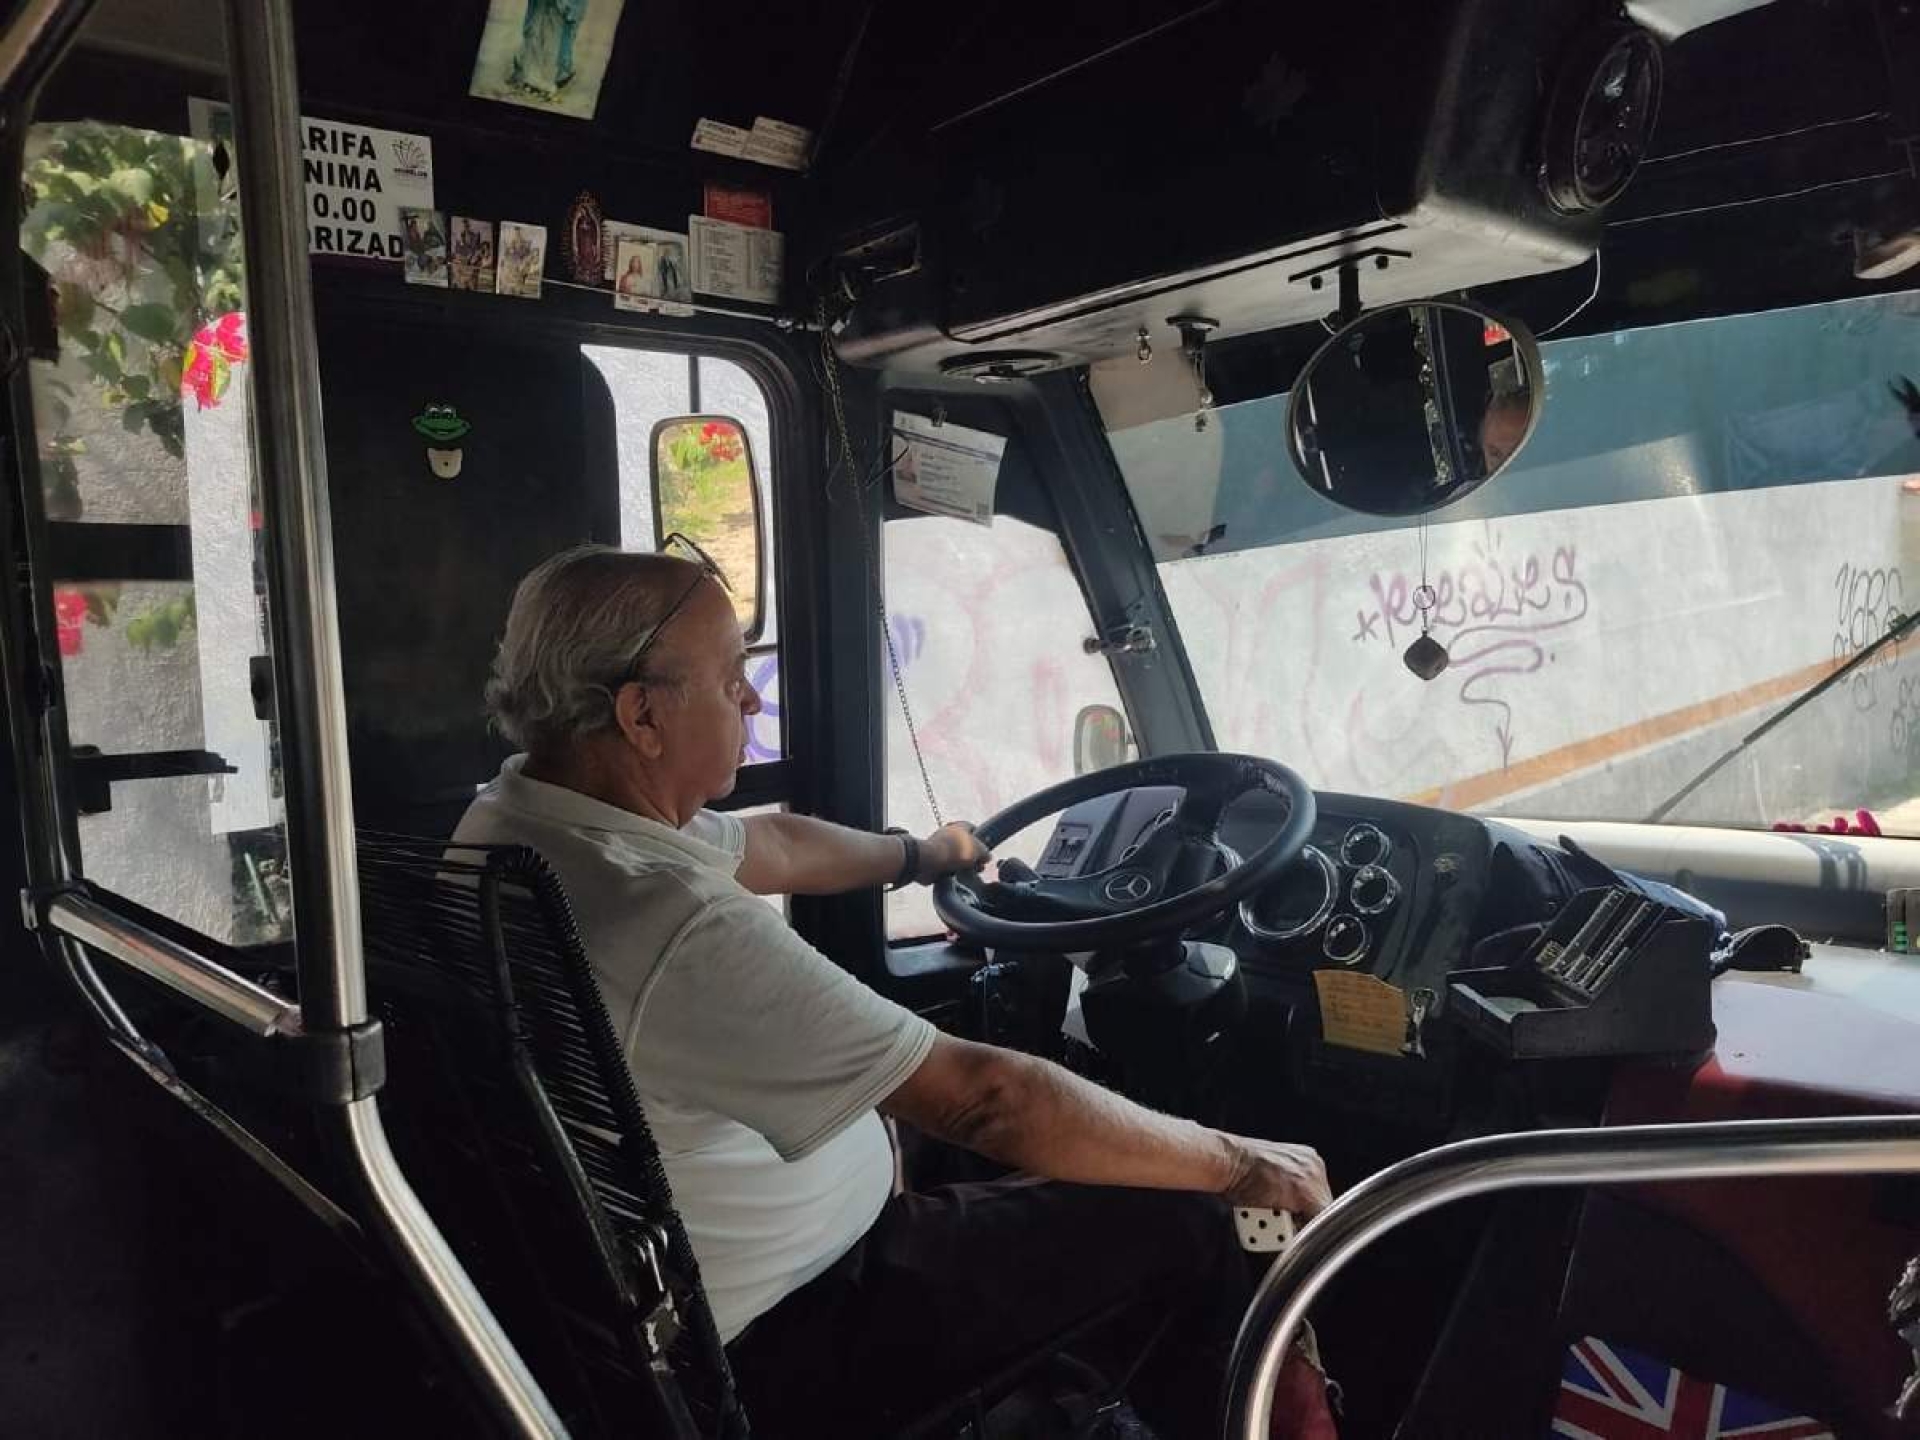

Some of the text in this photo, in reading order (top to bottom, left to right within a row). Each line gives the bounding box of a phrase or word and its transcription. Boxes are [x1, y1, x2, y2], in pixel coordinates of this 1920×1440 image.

[301, 126, 377, 160] RIFA
[303, 158, 383, 192] NIMA
[313, 191, 376, 224] 0.00
[307, 226, 404, 258] RIZAD
